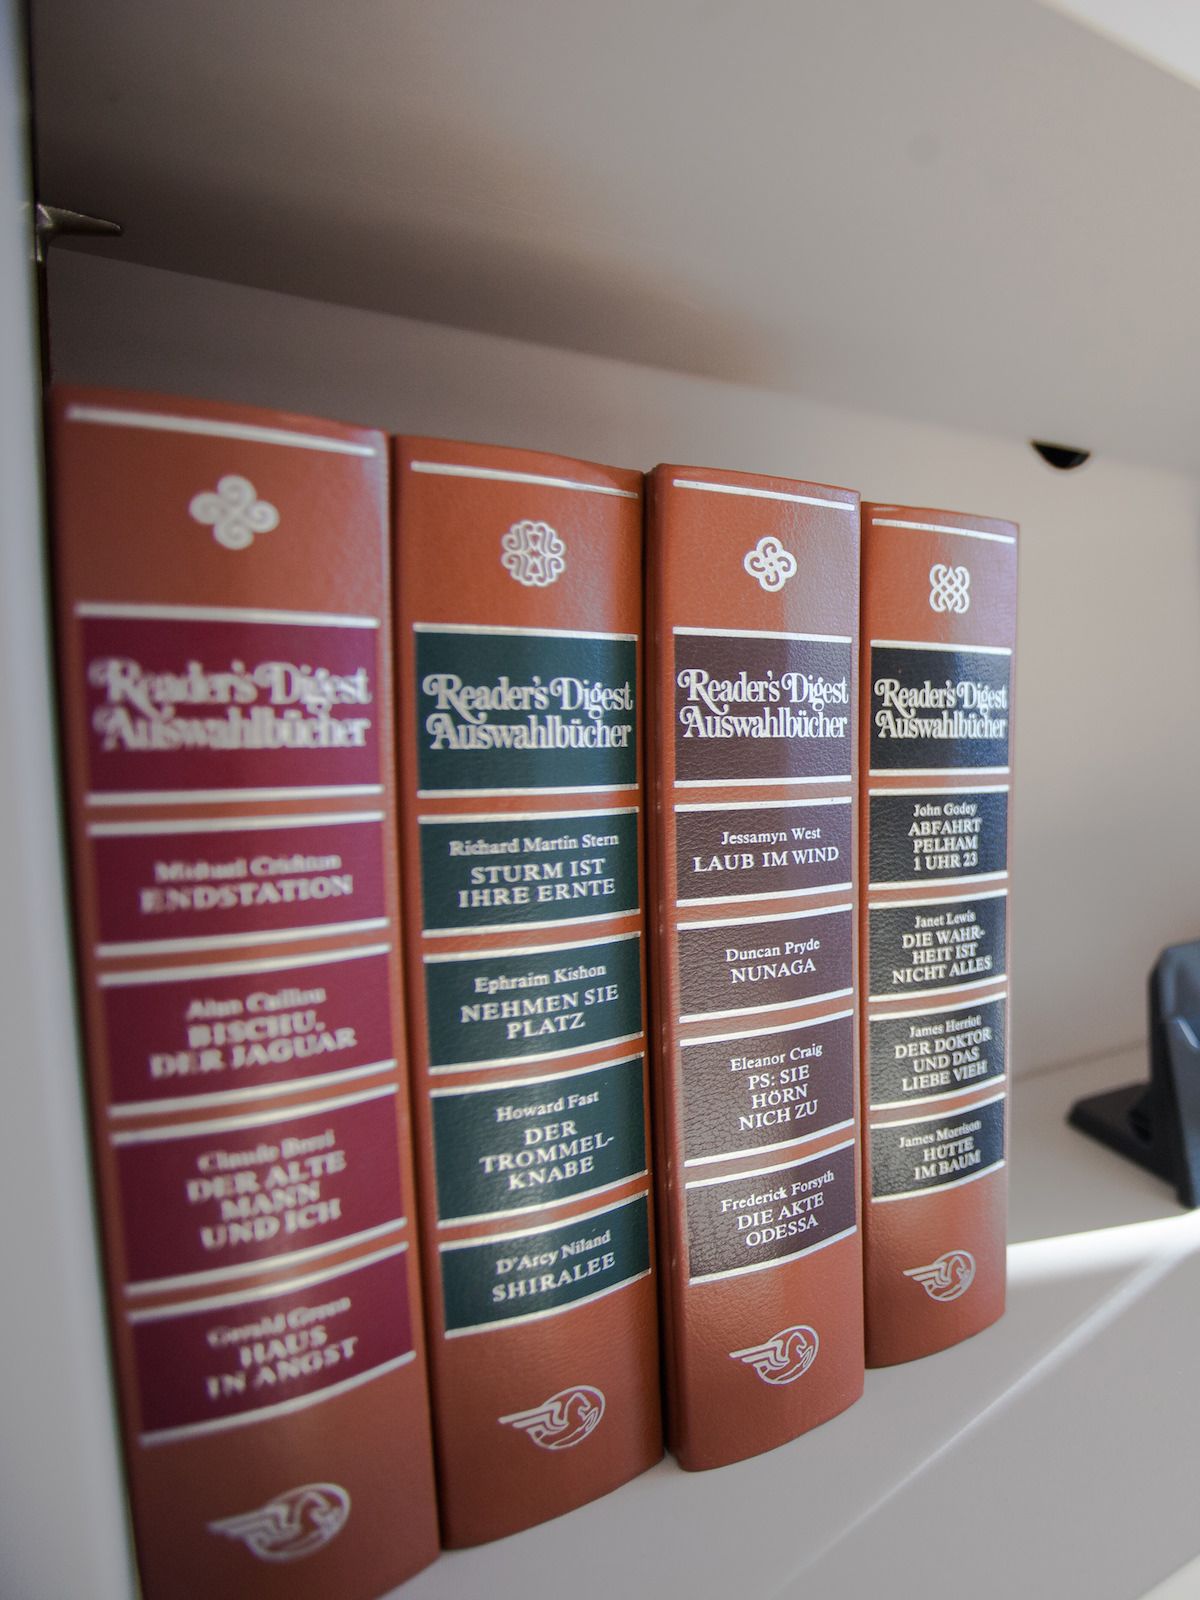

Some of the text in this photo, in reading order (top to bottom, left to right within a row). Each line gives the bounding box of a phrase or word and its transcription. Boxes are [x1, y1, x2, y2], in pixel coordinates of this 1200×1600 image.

[254, 661, 372, 715] Digest
[422, 673, 633, 724] Reader's Digest
[677, 669, 849, 715] Reader's Digest
[874, 678, 1007, 718] Reader's Digest
[426, 713, 632, 750] Auswahlbücher
[679, 705, 848, 738] Auswahlbücher
[875, 709, 1007, 739] Auswahlbücher
[913, 802, 977, 817] John Godey
[721, 827, 821, 845] Jessamyn West
[908, 818, 982, 837] ABFAHRT
[450, 834, 619, 856] Richard Martin Stern
[913, 835, 978, 853] PELHAM
[471, 858, 606, 884] STURM IST
[693, 846, 840, 873] LAUB IM WIND
[913, 852, 979, 871] 1 UHR 23
[140, 875, 353, 914] ENDSTATION
[458, 878, 616, 908] IHRE ERNTE
[914, 910, 975, 929] Janet Lewis
[725, 938, 820, 962] Duncan Pryde
[901, 925, 985, 949] DIE WAHR-
[912, 942, 978, 965] HEIT IST
[474, 965, 607, 995] Ephraim Kishon
[731, 958, 816, 984] NUNAGA
[892, 955, 993, 984] NICHT ALLES
[460, 984, 619, 1023] NEHMEN SIE
[506, 1012, 586, 1040] PLATZ
[909, 1015, 981, 1038] James Herriot
[150, 1027, 357, 1079] DER JAGUAR
[730, 1043, 823, 1072] Eleanor Craig
[894, 1027, 992, 1059] DER DOKTOR
[913, 1047, 980, 1073] UND DAS
[748, 1064, 810, 1090] PS: SIE
[902, 1060, 988, 1091] LIEBE VIEH
[496, 1091, 599, 1122] Howard Fast
[751, 1084, 809, 1109] HÖRN
[739, 1099, 818, 1131] NICH ZU
[524, 1119, 578, 1146] DER
[899, 1120, 982, 1149] James Morrison
[478, 1132, 615, 1174] TROMMEL-
[914, 1150, 982, 1180] IM BAUM
[186, 1150, 347, 1204] DER ALTE
[508, 1156, 595, 1191] KNABE
[220, 1180, 320, 1221] MANN
[721, 1170, 835, 1213] Frederick Forsyth
[200, 1198, 342, 1250] UND ICH
[737, 1192, 824, 1230] DIE AKTE
[745, 1214, 819, 1247] ODESSA
[496, 1230, 611, 1275] D'Arcy Niland
[492, 1252, 616, 1302] SHIRALEE
[239, 1325, 328, 1369] HAUS
[206, 1336, 358, 1399] IN ANGST
